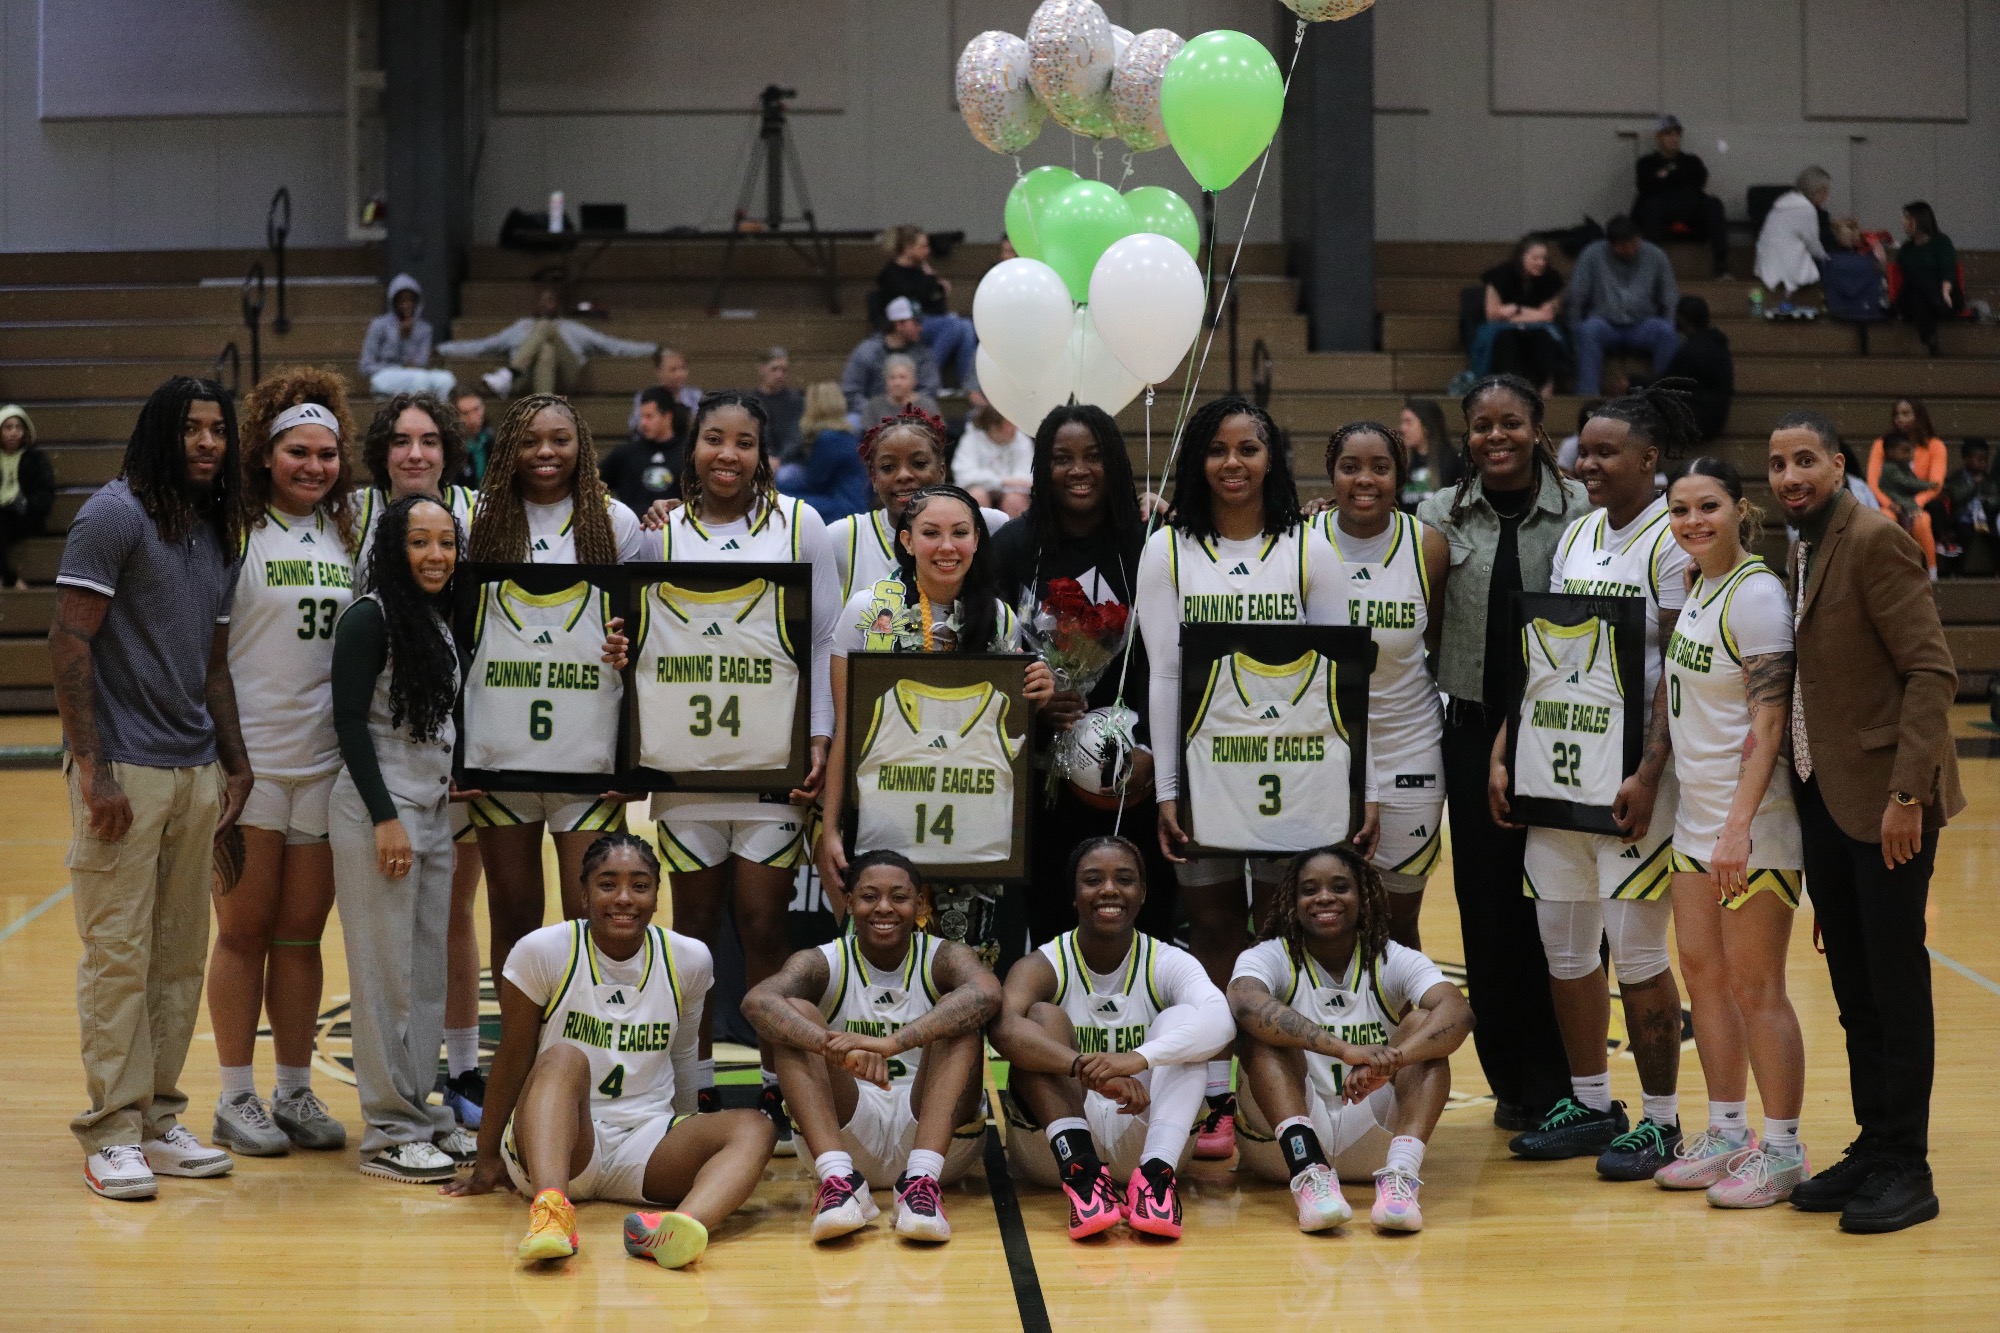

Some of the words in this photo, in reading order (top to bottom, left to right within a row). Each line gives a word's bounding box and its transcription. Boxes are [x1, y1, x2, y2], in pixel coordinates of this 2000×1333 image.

[266, 560, 315, 587] RUNNING
[297, 598, 338, 640] 33
[1184, 594, 1244, 622] RUNNING
[1248, 593, 1297, 621] EAGLES
[1366, 600, 1416, 629] EAGLES
[656, 654, 713, 684] RUNNING
[718, 655, 773, 685] EAGLES
[1676, 635, 1713, 674] EAGLES
[485, 660, 542, 689] RUNNING
[547, 661, 600, 690] EAGLES
[529, 700, 553, 741] 6
[688, 694, 741, 738] 34
[1531, 700, 1570, 730] RUNNING
[1570, 703, 1611, 735] EAGLES
[1212, 735, 1268, 763] RUNNING
[1274, 735, 1325, 763] EAGLES
[1552, 741, 1582, 788] 22
[878, 765, 936, 794] RUNNING
[942, 766, 995, 794] EAGLES
[1258, 773, 1282, 817] 3
[914, 803, 954, 845] 14
[562, 1010, 614, 1049] RUNNING
[618, 1022, 671, 1052] EAGLES
[598, 1063, 625, 1099] 4
